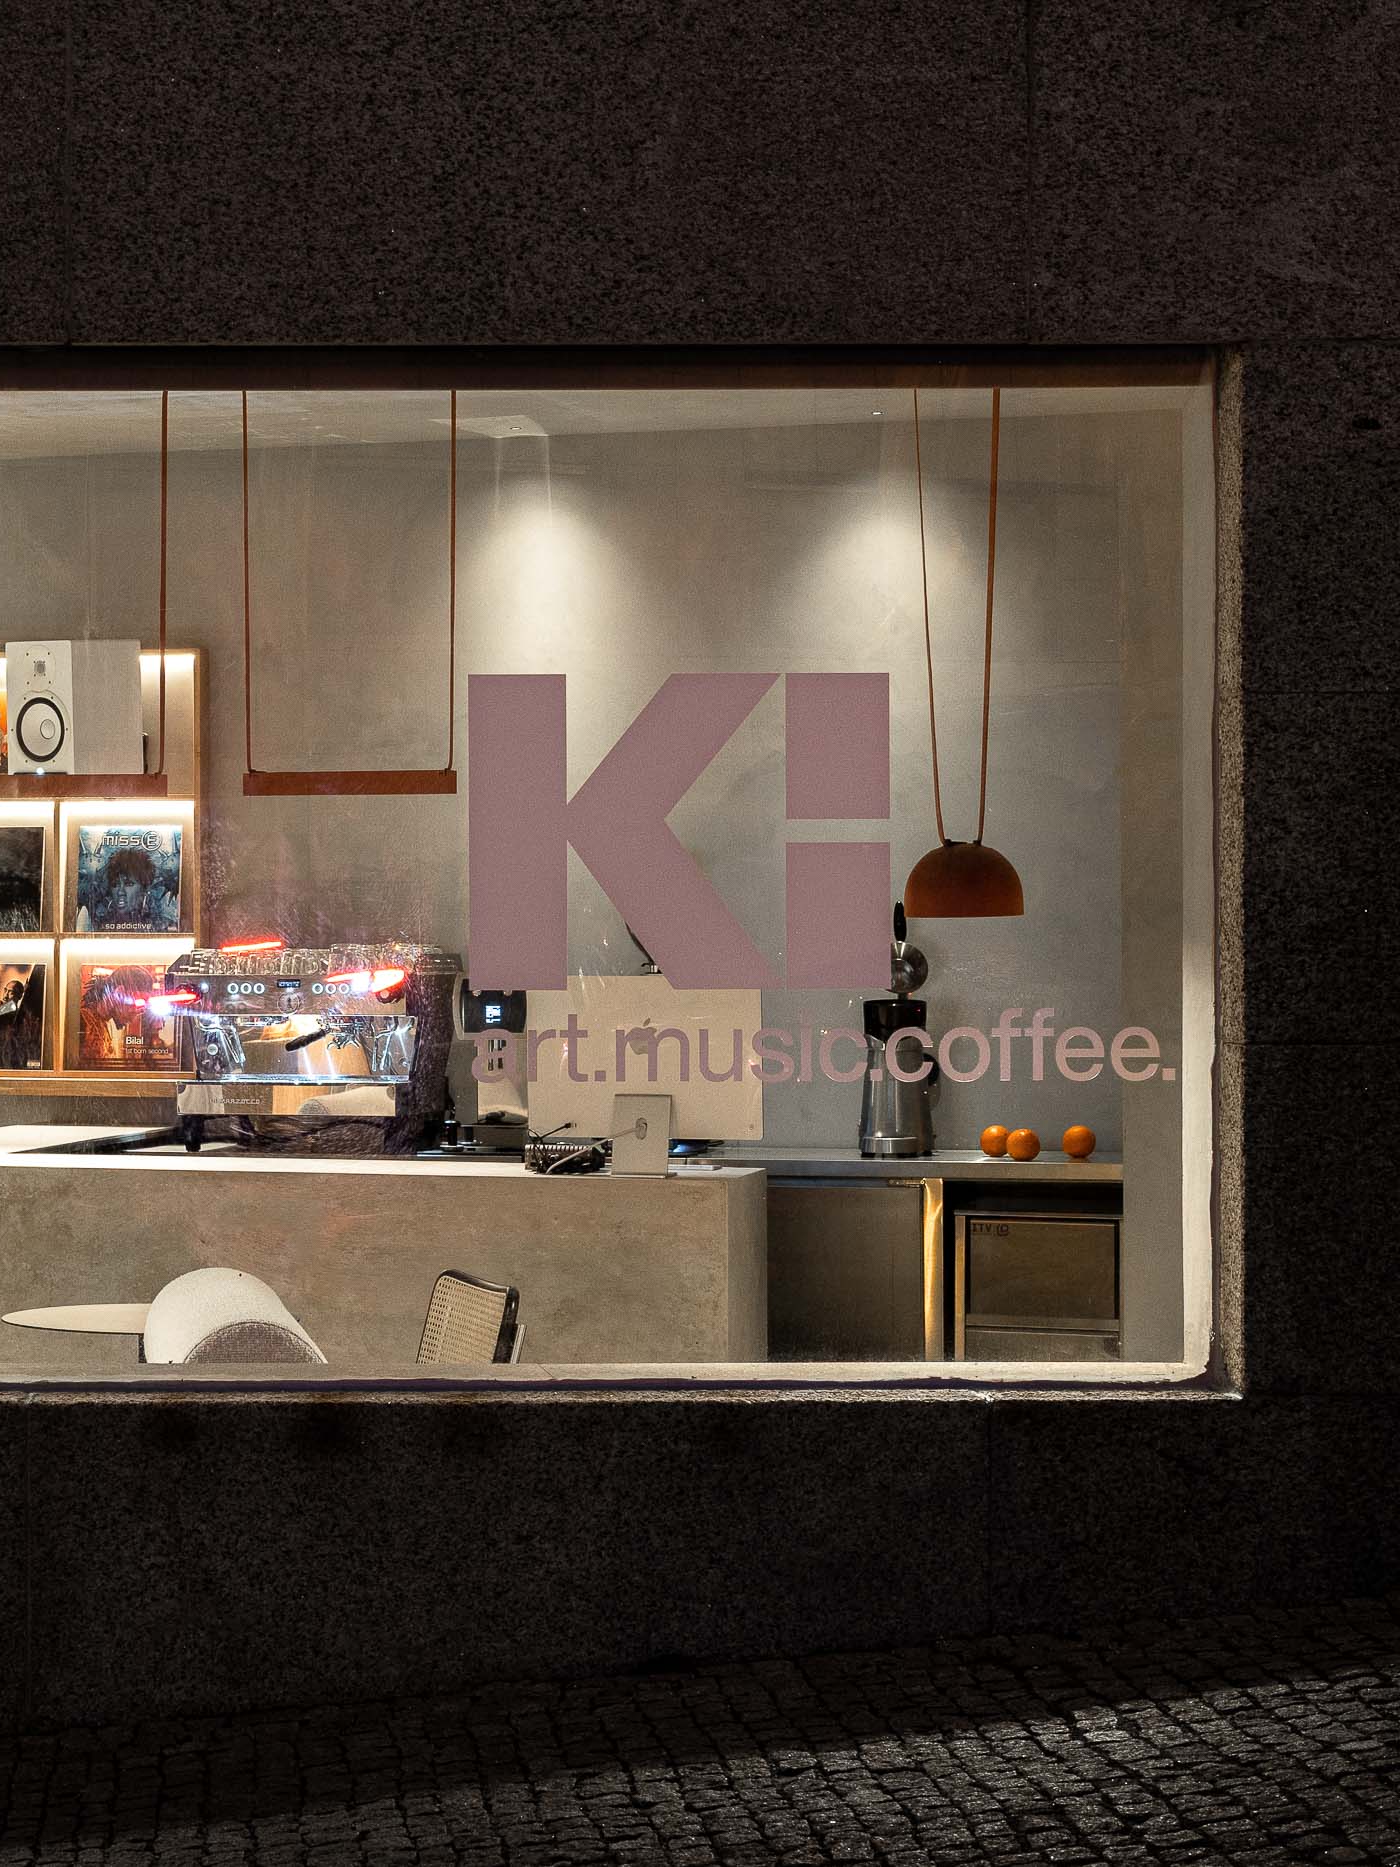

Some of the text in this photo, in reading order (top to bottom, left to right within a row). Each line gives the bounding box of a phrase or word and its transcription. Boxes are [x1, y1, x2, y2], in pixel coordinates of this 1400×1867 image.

[102, 832, 140, 846] miss
[105, 921, 152, 930] so addictive
[125, 1036, 144, 1045] Bilal
[471, 1007, 1176, 1084] art.music.coffee.
